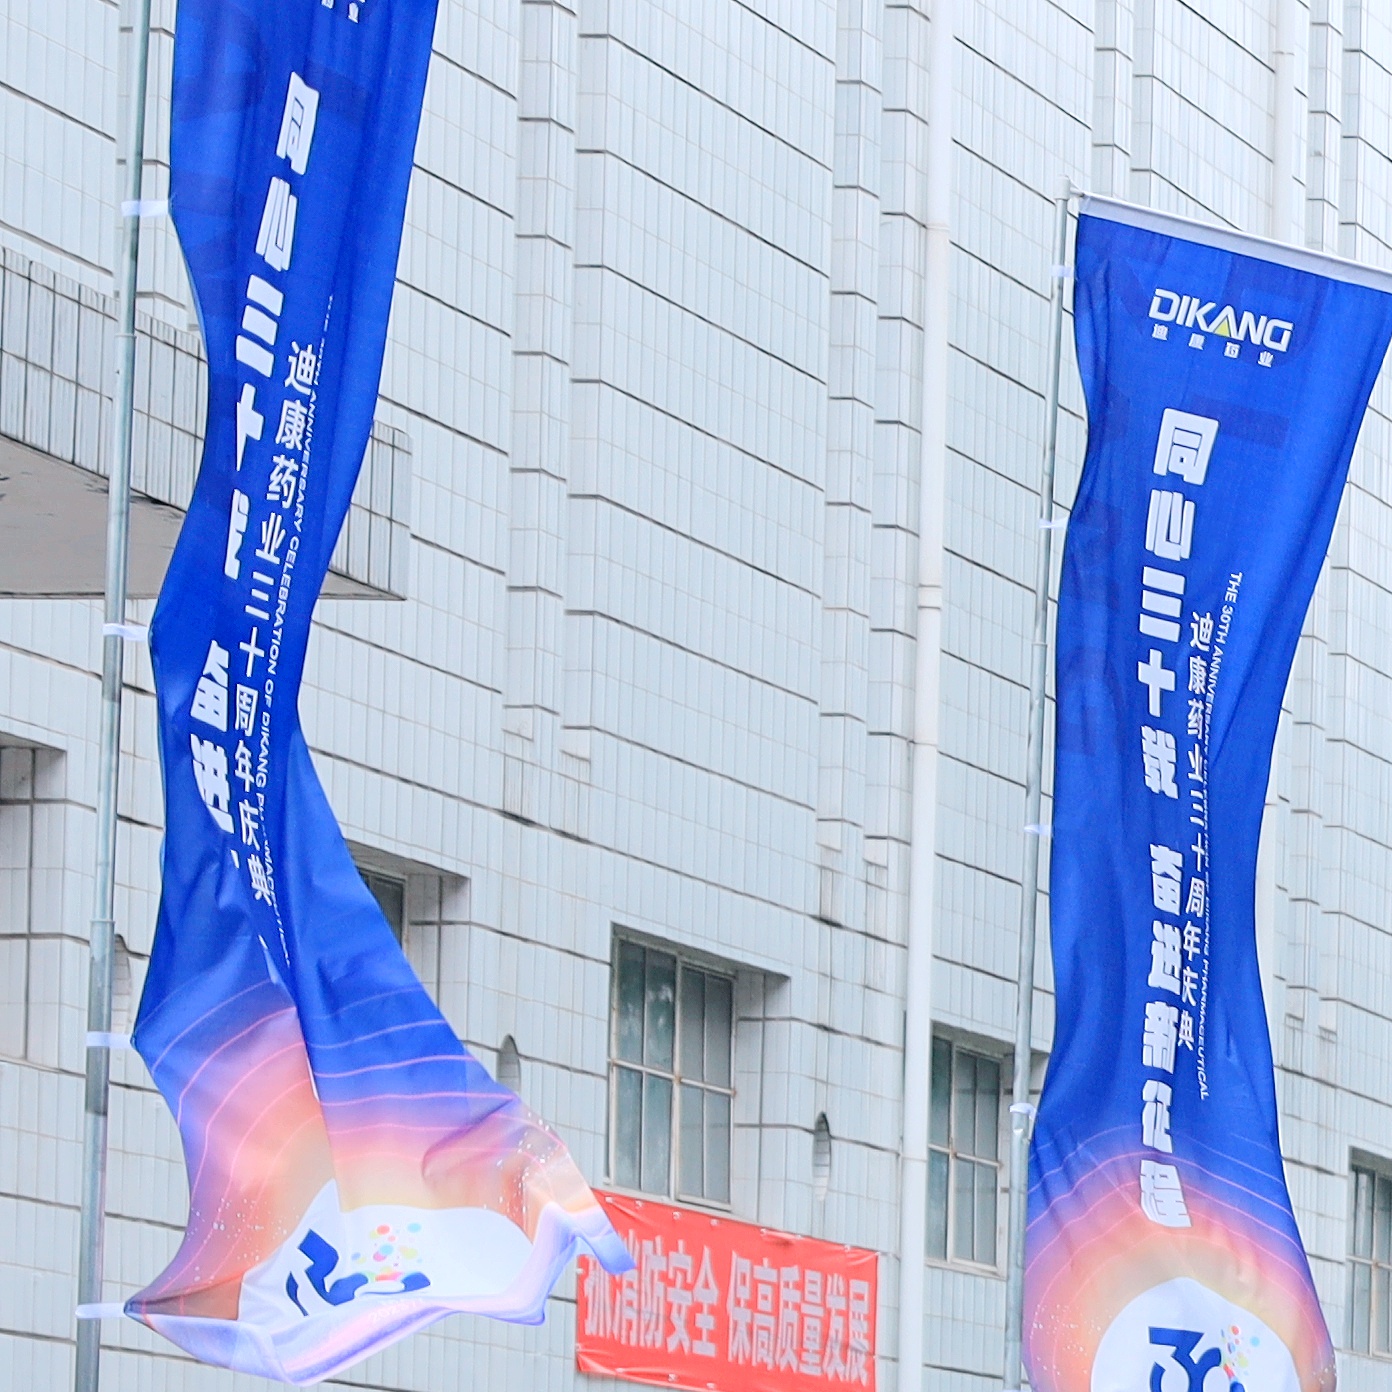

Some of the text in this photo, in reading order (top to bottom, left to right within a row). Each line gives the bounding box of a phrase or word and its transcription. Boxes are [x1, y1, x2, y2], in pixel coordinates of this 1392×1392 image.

[1149, 288, 1294, 352] DIKANG
[267, 536, 300, 675] CELEBRATION
[1224, 572, 1243, 603] THE
[1215, 605, 1234, 644] 30TH
[265, 680, 274, 708] OF
[255, 711, 271, 788] DIKANG
[727, 1250, 869, 1386] 保高质量发展
